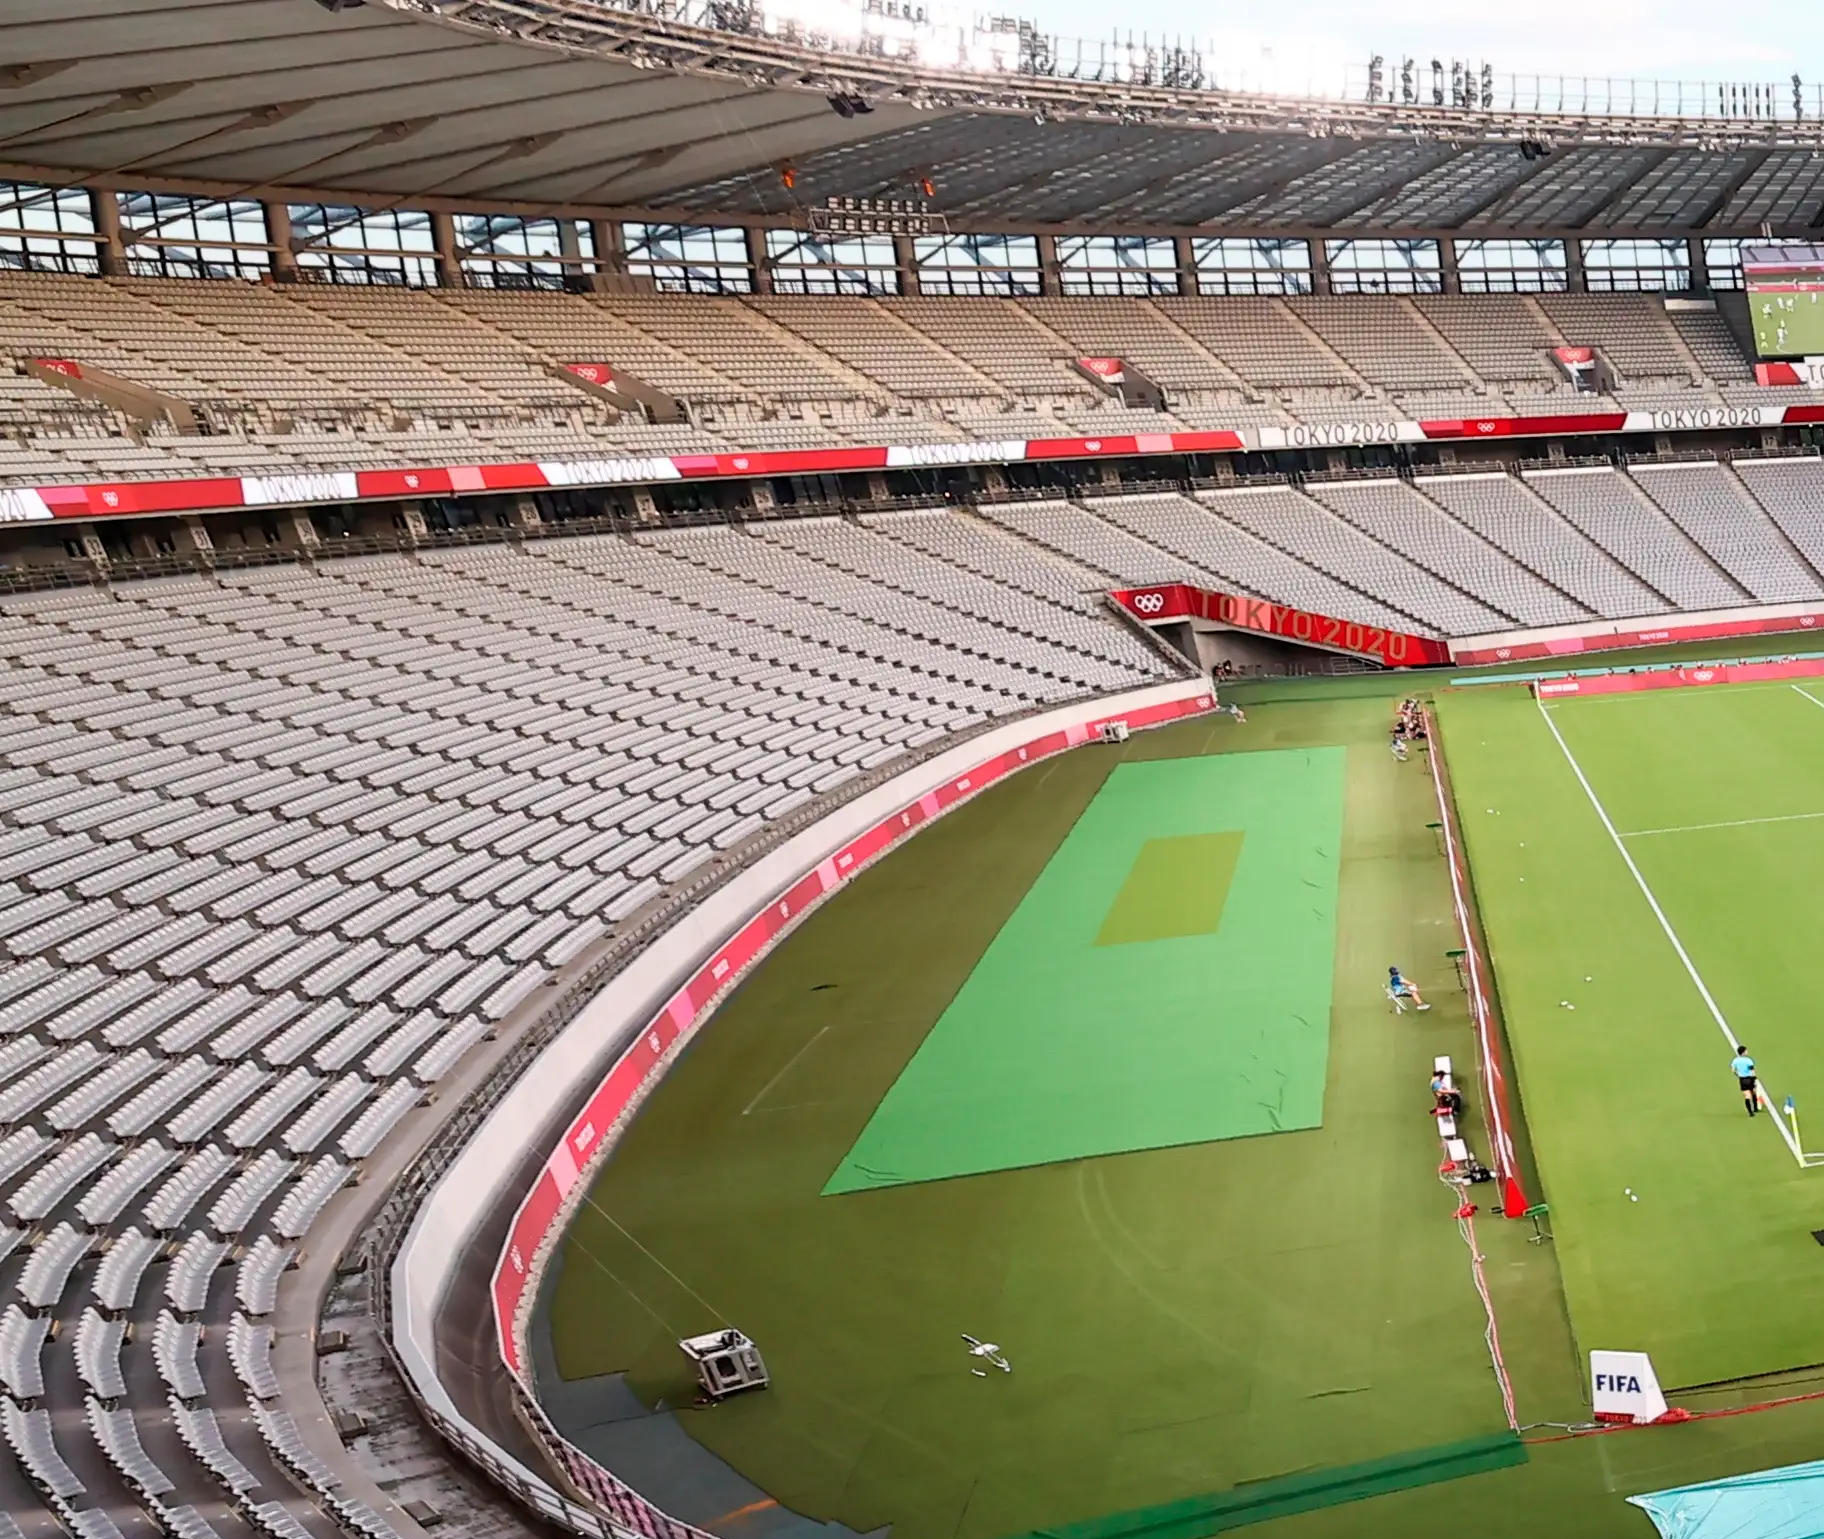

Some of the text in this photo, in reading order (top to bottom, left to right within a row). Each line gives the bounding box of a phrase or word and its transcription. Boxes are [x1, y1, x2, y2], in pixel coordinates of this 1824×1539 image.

[1649, 406, 1761, 429] TOKYO 2020
[1281, 421, 1399, 447] TOKYO 2020
[1199, 591, 1407, 659] TOKYO 2020
[1596, 1374, 1642, 1394] FIFA
